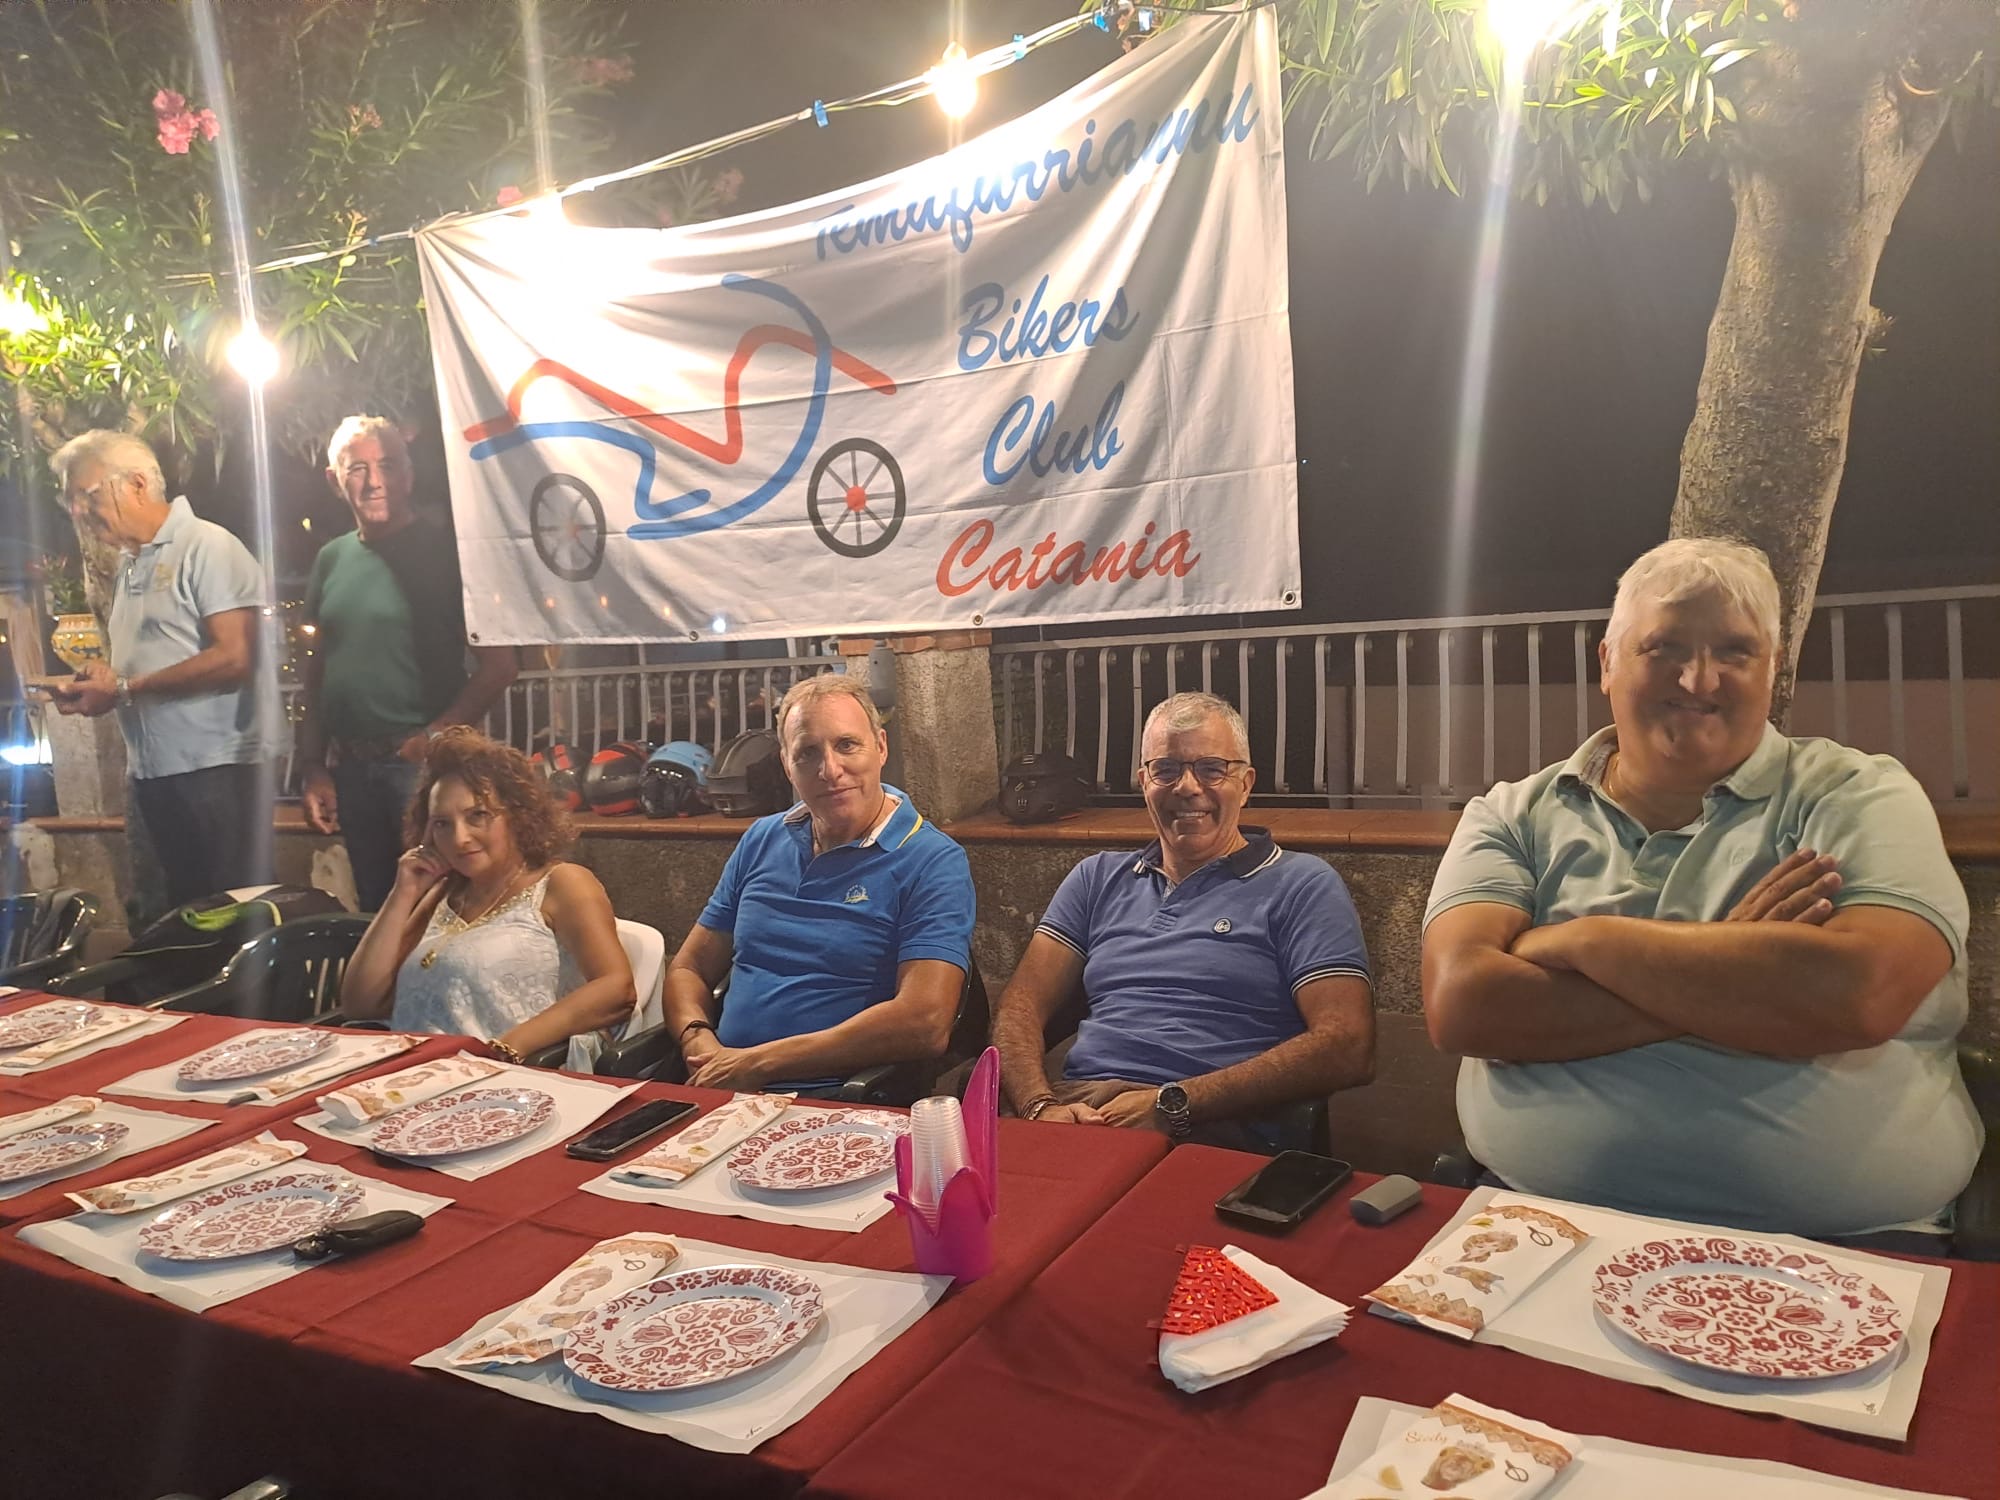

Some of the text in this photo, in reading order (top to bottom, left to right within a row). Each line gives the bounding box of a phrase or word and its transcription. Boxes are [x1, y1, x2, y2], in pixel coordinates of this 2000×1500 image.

[957, 274, 1140, 370] Bikers
[983, 380, 1125, 485] Club
[936, 518, 1200, 597] Catania
